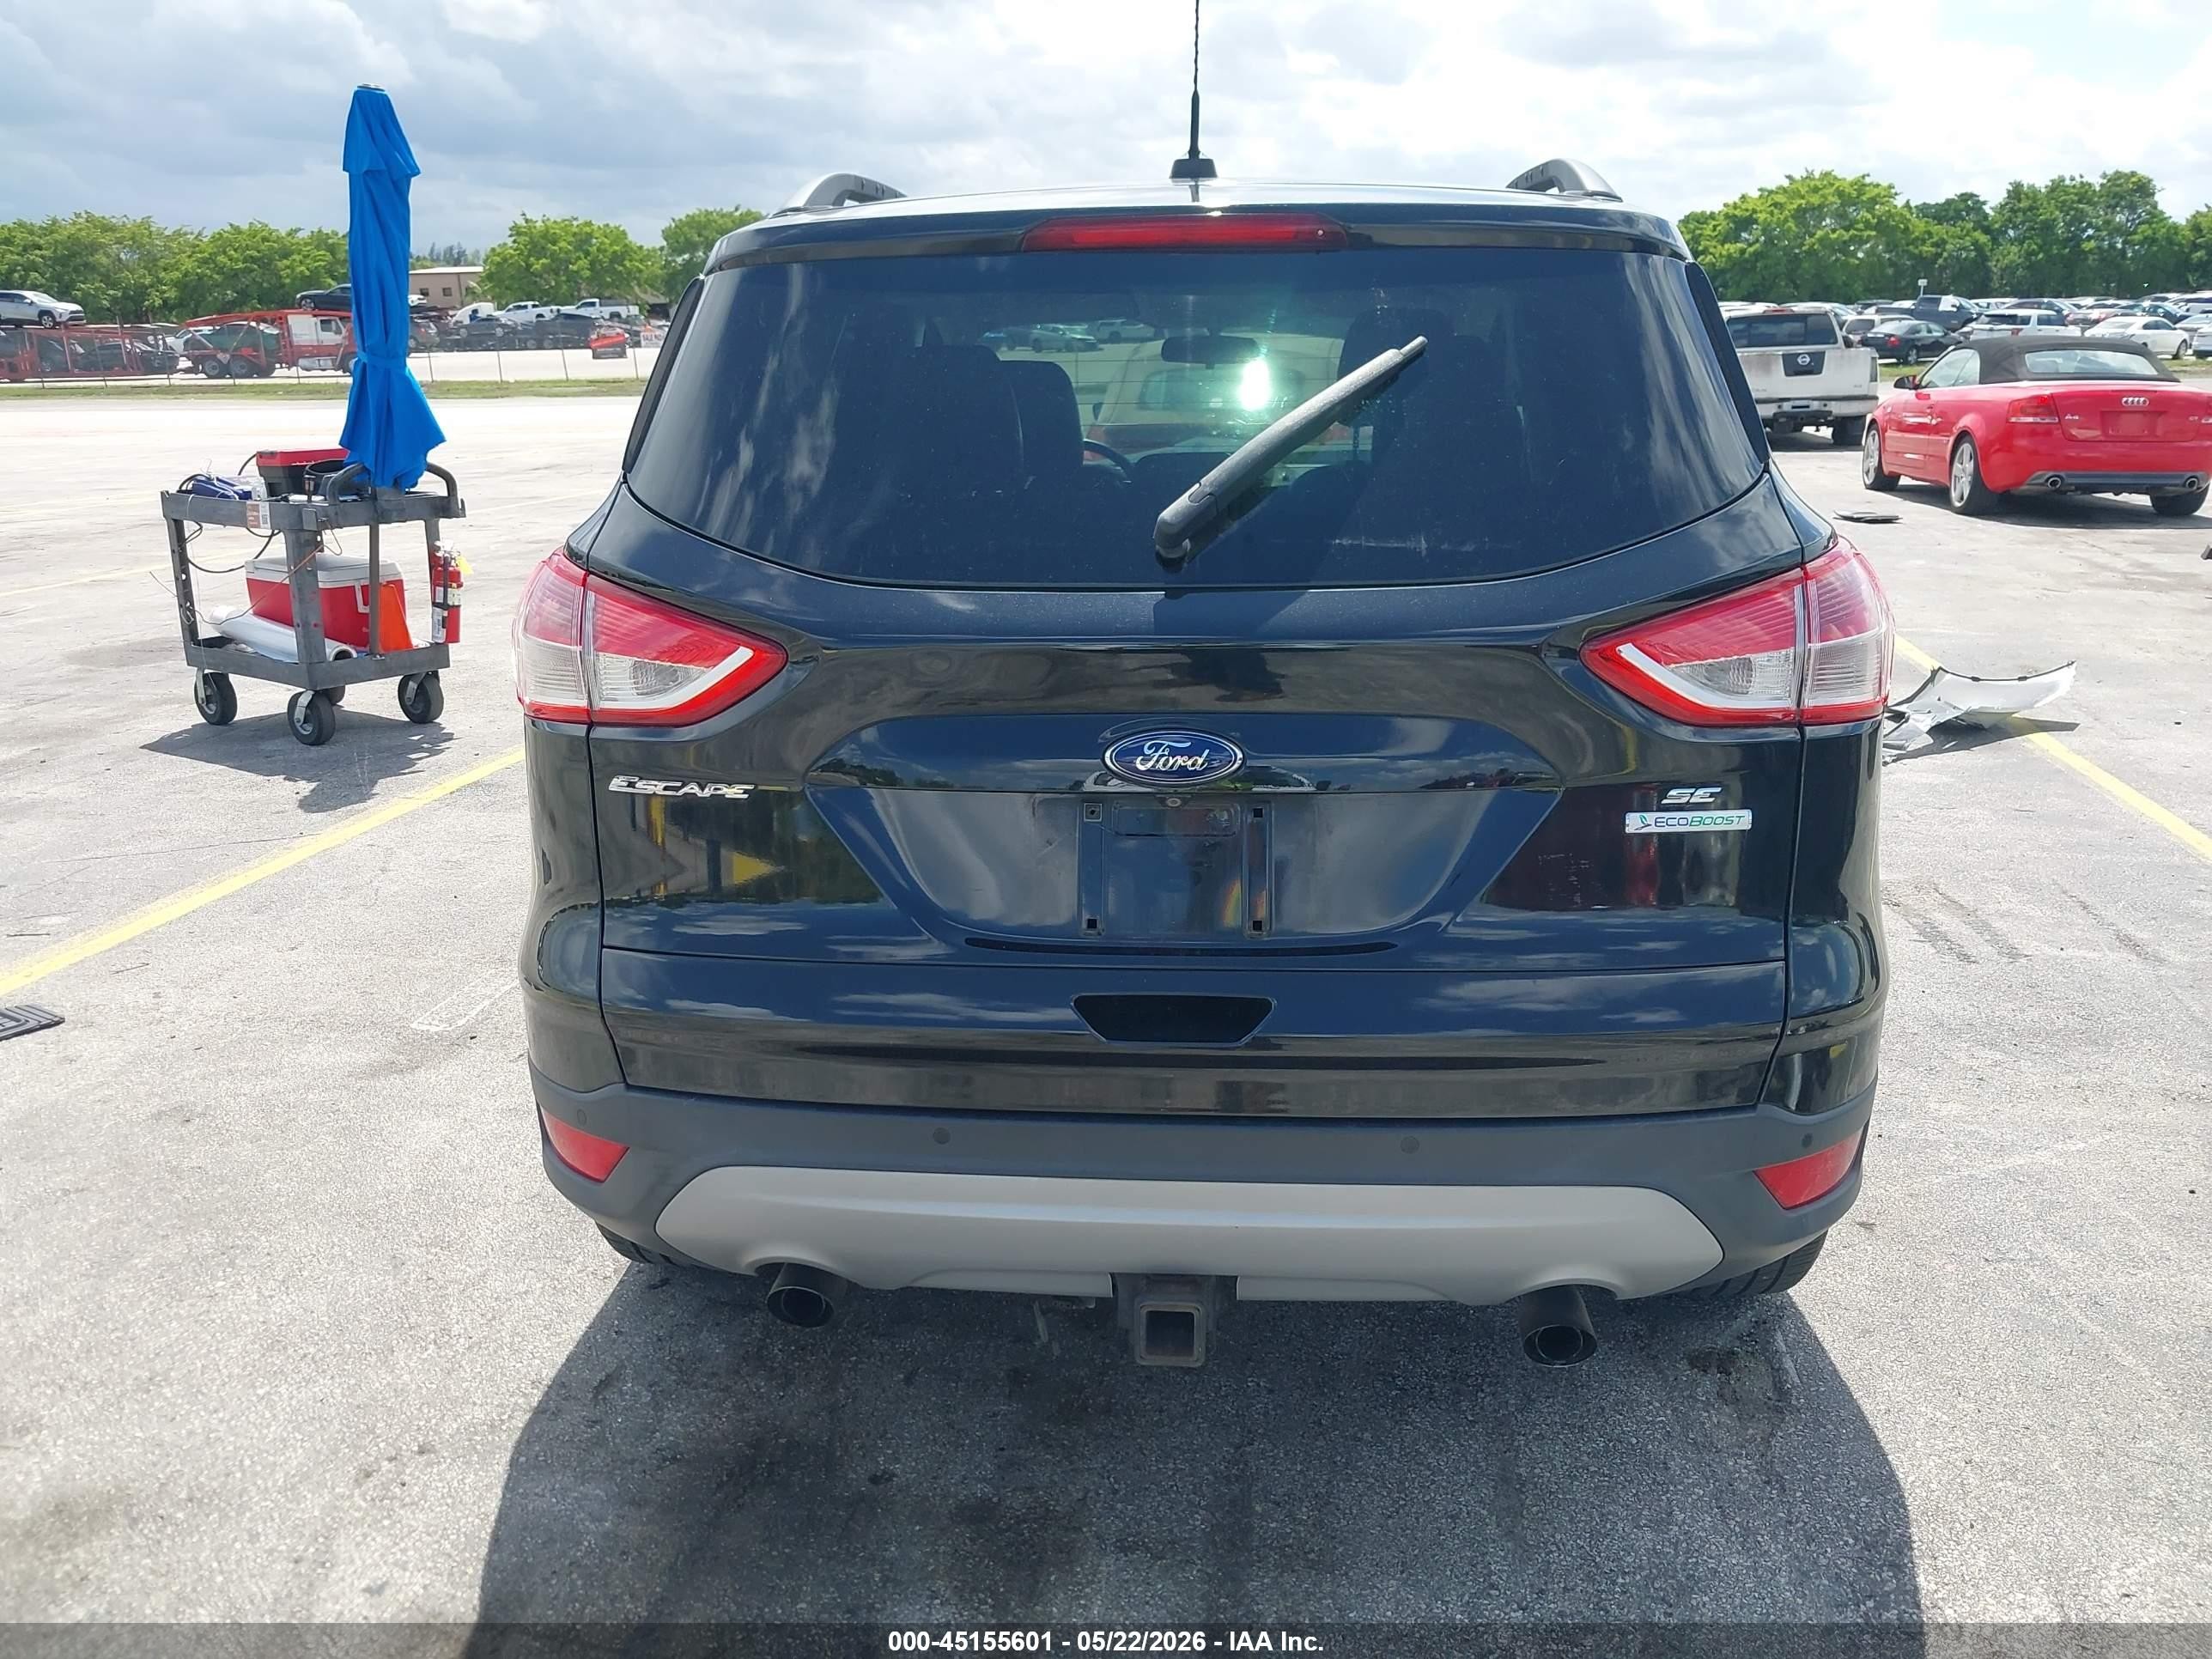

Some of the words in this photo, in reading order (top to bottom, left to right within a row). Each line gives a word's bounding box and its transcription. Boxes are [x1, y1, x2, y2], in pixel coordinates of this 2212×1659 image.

[1134, 739, 1210, 771] Ford
[608, 775, 756, 799] ESCAPE
[1661, 787, 1723, 805] SE
[1654, 815, 1746, 828] ECOBOOST
